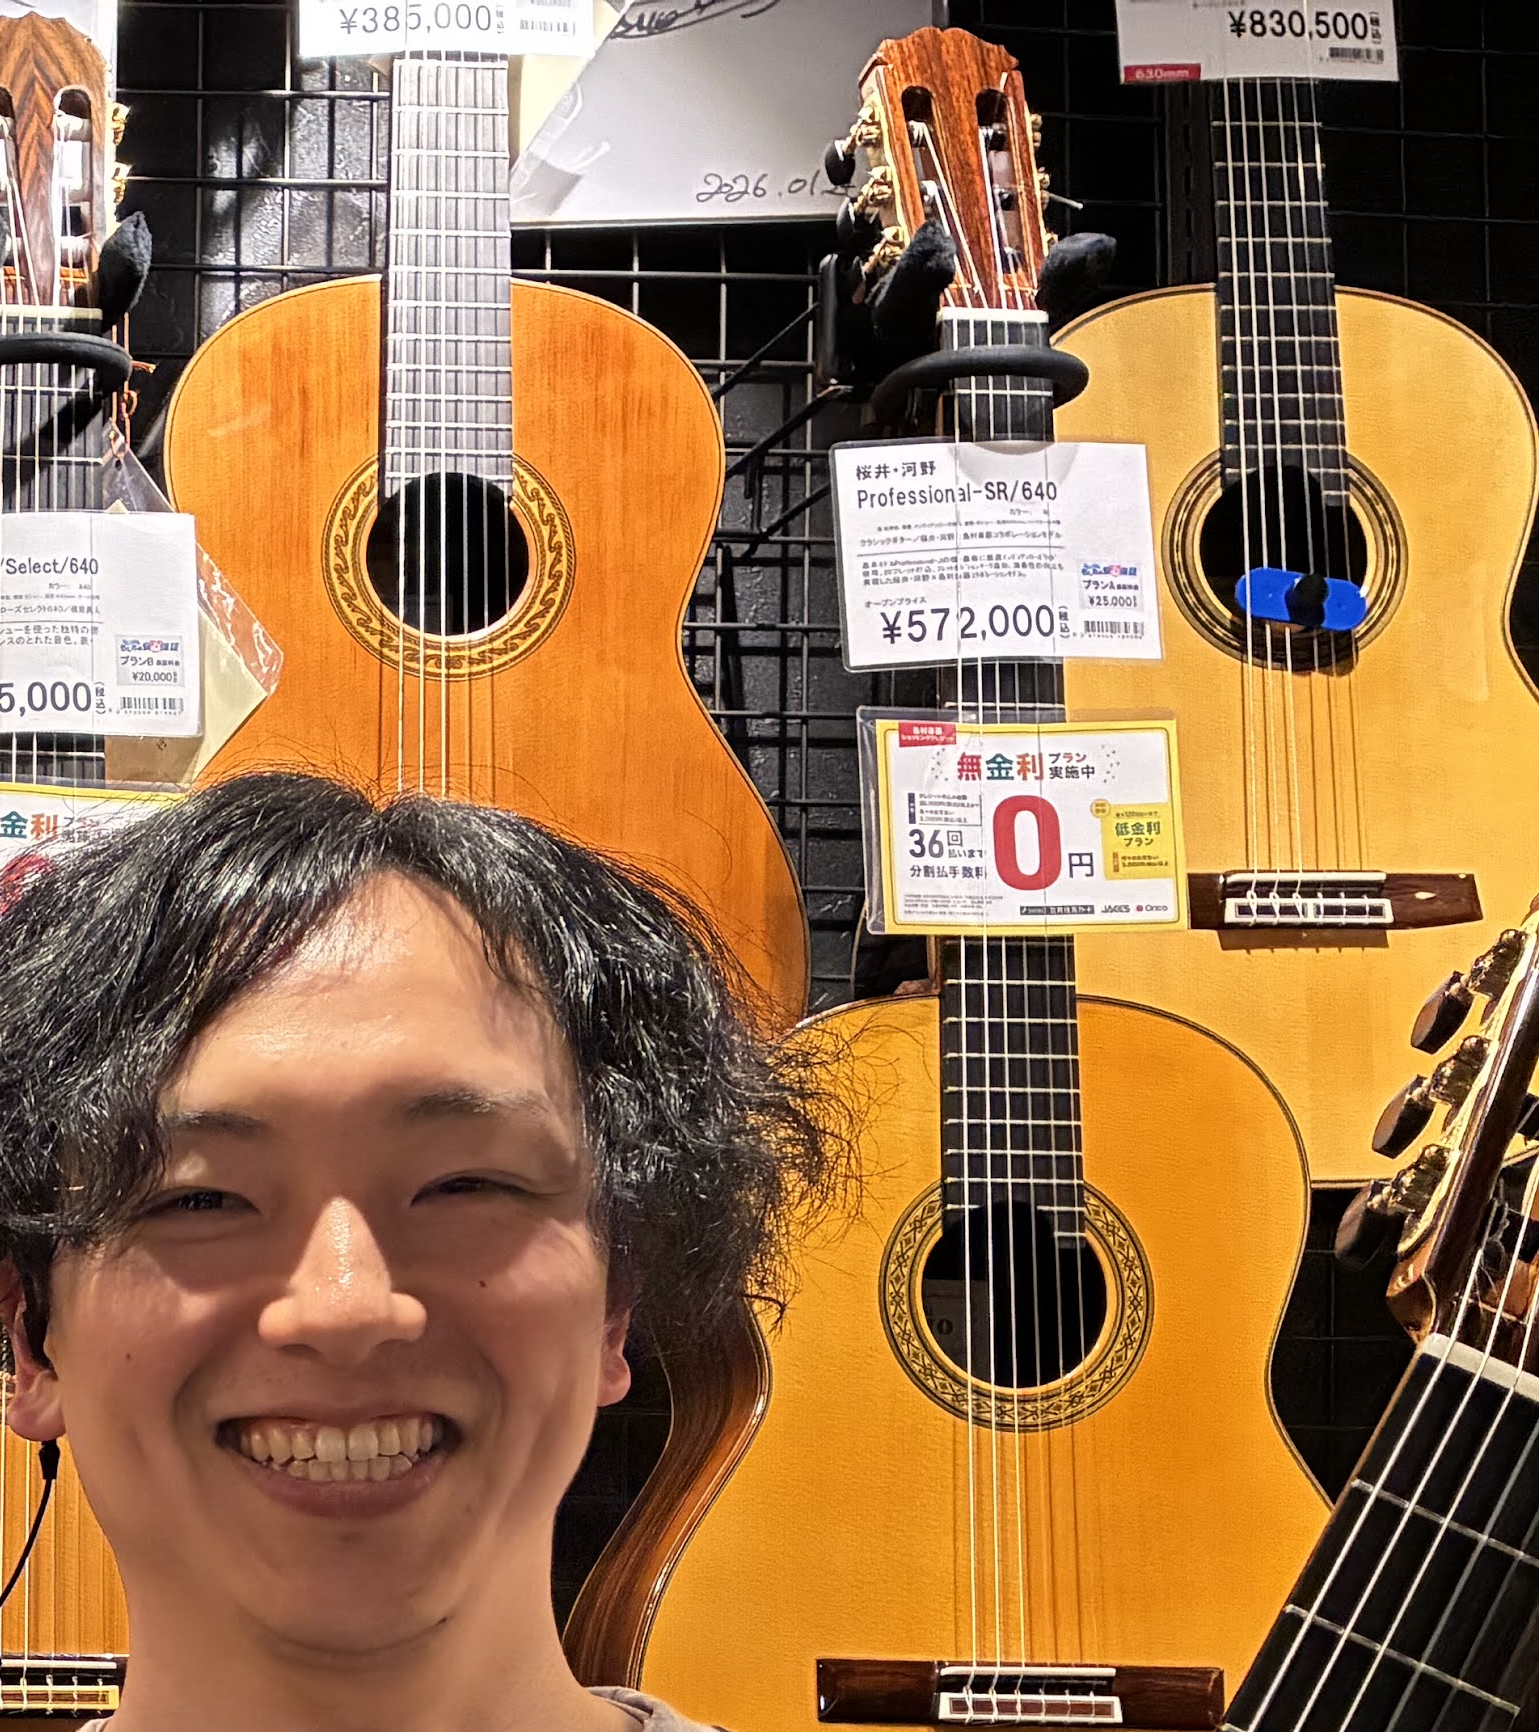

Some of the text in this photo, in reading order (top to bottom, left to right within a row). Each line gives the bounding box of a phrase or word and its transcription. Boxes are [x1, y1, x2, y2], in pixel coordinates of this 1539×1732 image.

[339, 3, 492, 35] ¥385,000
[1229, 10, 1368, 40] ¥830,500
[856, 460, 937, 481] 桜井・河野
[857, 481, 1058, 510] Professional-SR/640
[880, 604, 1055, 644] ¥572,000
[132, 671, 173, 683] ¥20,000
[957, 751, 1043, 782] 無金利
[1048, 752, 1087, 764] プラン
[1049, 765, 1096, 780] 実施中
[908, 828, 963, 859] 36 回
[992, 795, 1095, 891] 0 円
[1115, 820, 1162, 838] 低金利
[1124, 836, 1154, 848] プラン
